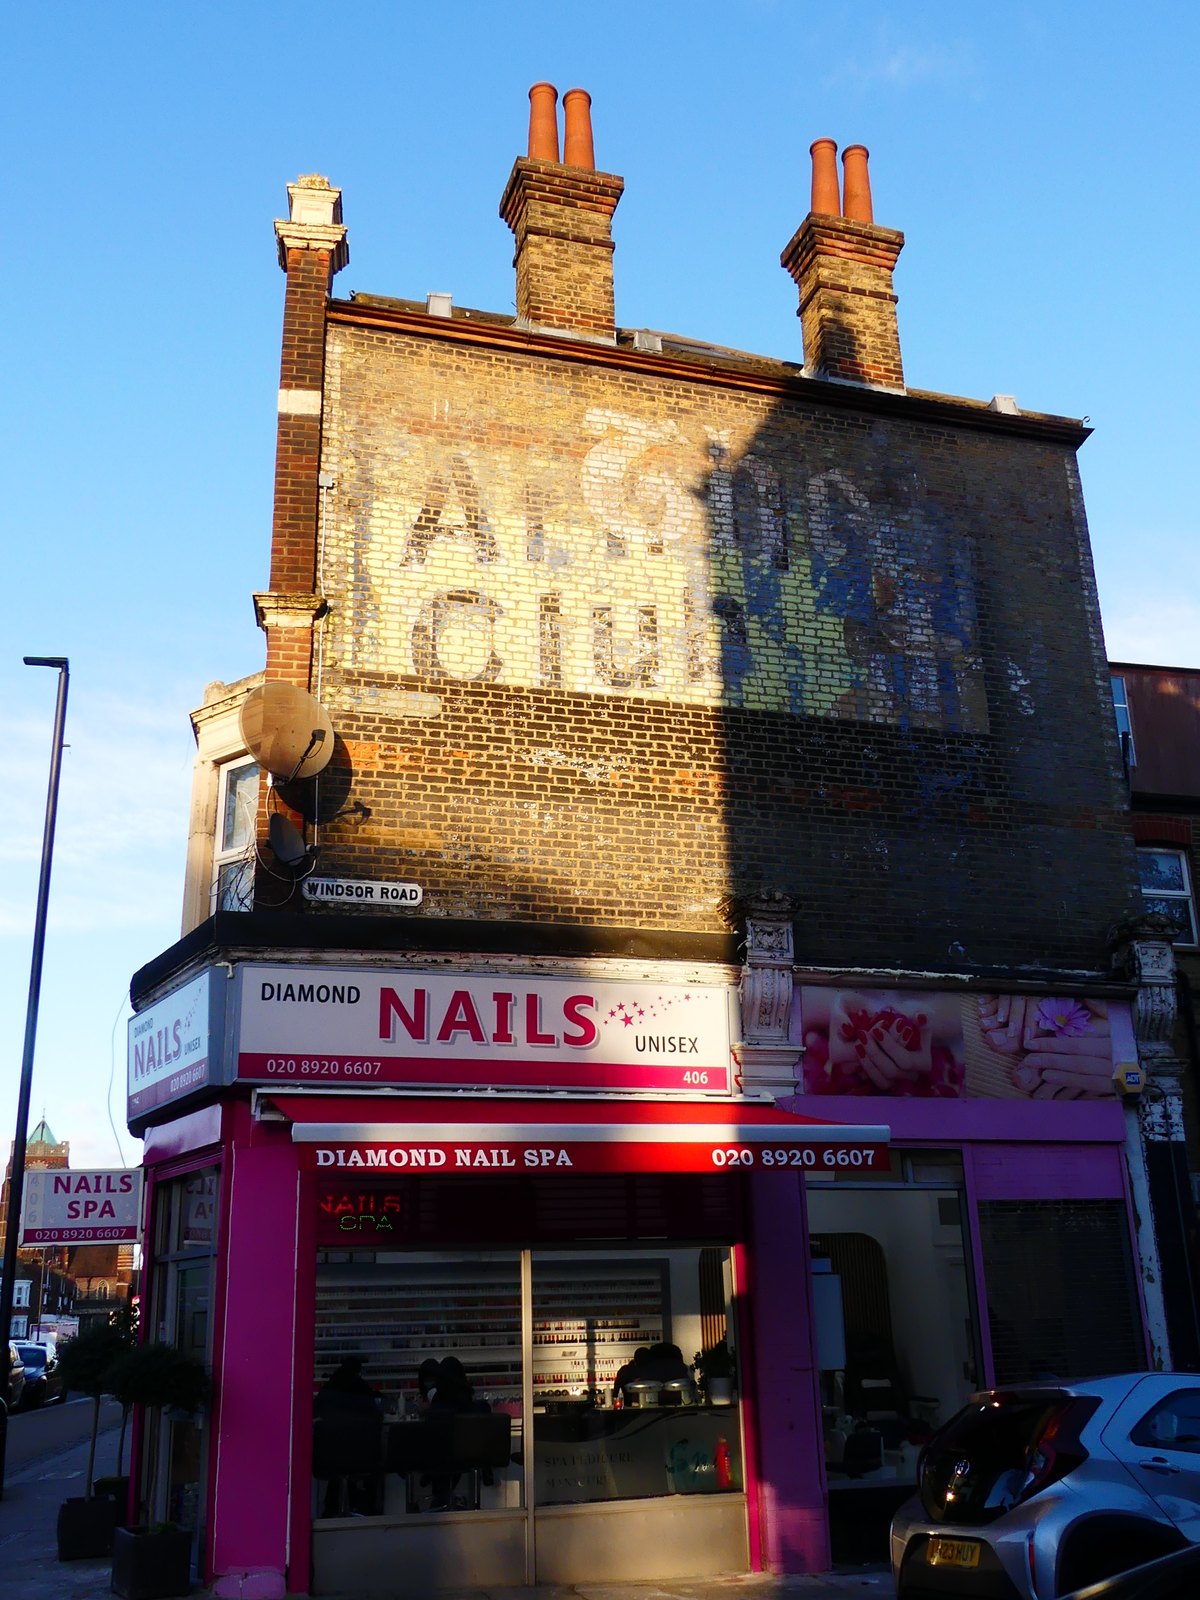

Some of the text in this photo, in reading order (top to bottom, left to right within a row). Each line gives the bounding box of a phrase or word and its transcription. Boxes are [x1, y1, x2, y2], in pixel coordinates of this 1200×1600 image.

[307, 882, 418, 901] WINDSOR ROAD
[261, 982, 361, 1004] DIAMOND
[379, 987, 598, 1047] NAILS
[134, 1017, 154, 1038] DIAMOND
[134, 1018, 181, 1079] NAILS
[635, 1035, 698, 1054] UNISEX
[267, 1059, 382, 1075] 020 8920 6607
[683, 1071, 709, 1085] 406
[316, 1149, 573, 1167] DIAMOND NAIL SPA
[711, 1149, 875, 1166] 020 8920 6607
[54, 1174, 133, 1194] NAILS
[67, 1200, 116, 1219] SPA
[339, 1214, 393, 1231] SPA
[35, 1228, 127, 1240] 020 8920 6607
